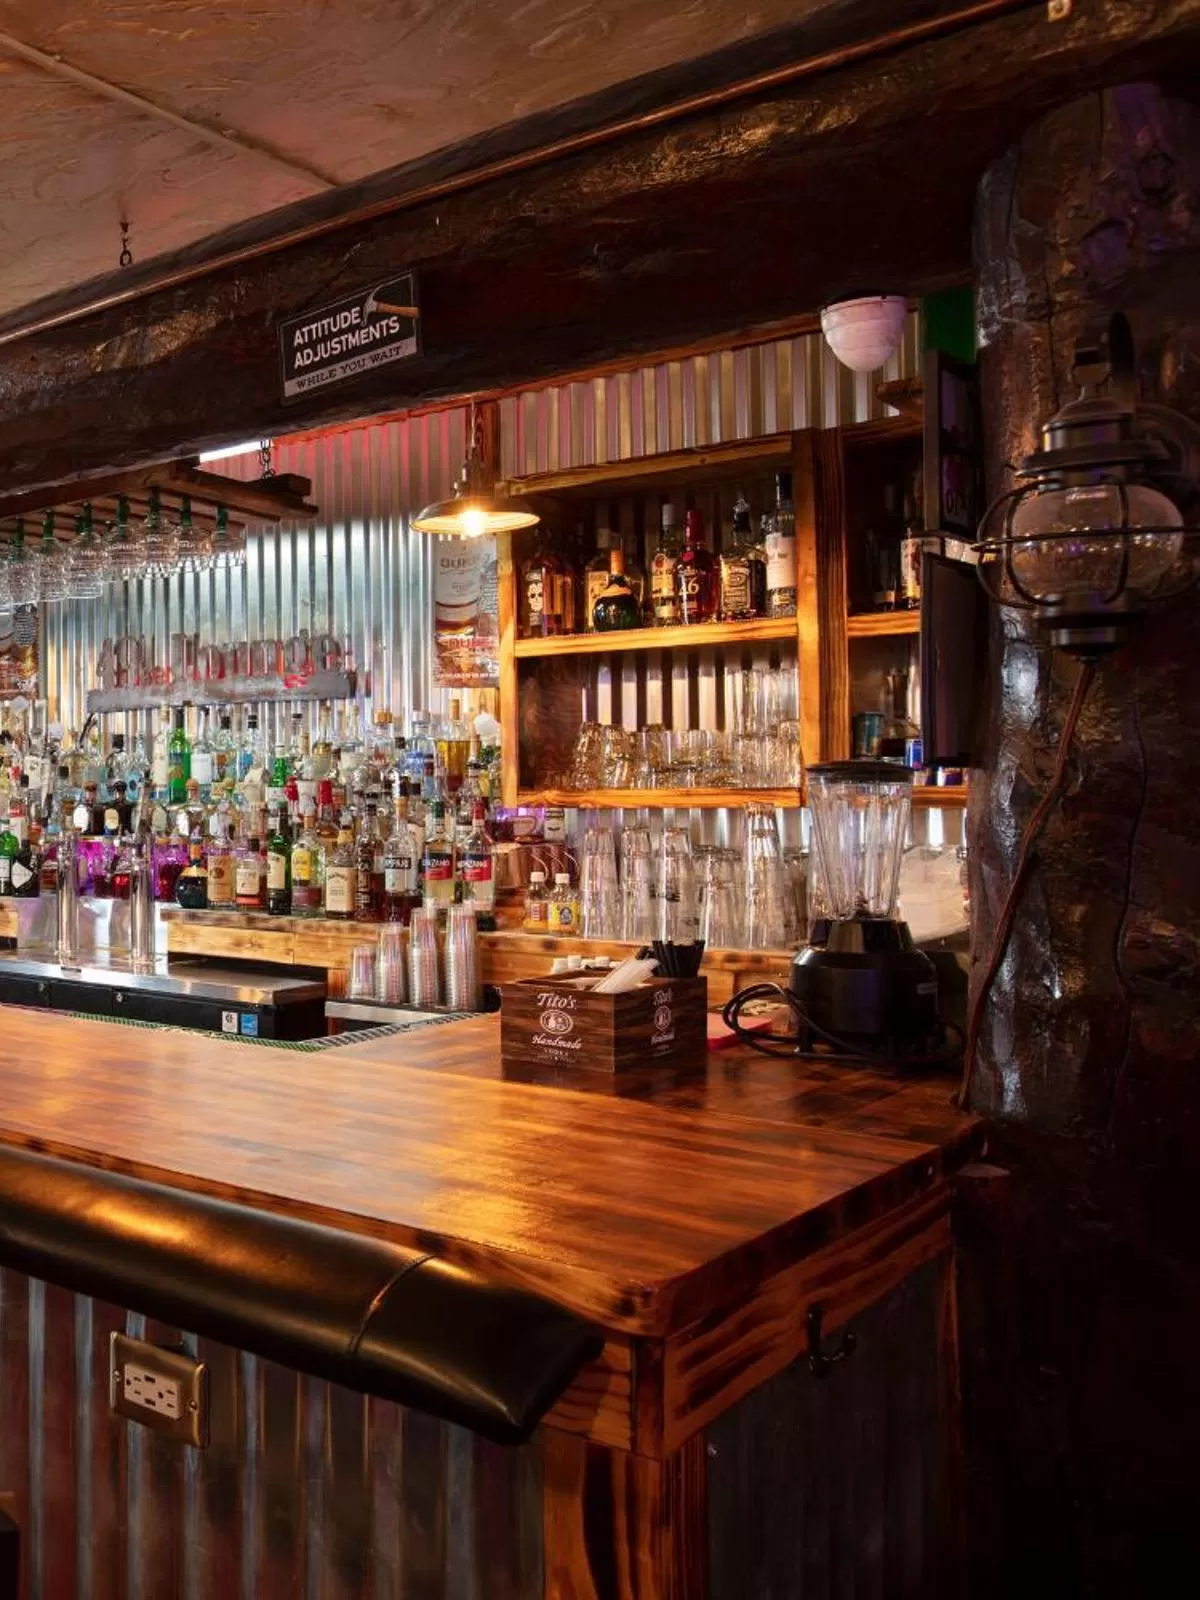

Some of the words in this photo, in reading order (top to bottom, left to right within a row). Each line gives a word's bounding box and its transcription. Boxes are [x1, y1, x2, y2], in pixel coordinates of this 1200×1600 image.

[294, 306, 362, 347] ATTITUDE
[294, 316, 400, 370] ADJUSTMENTS
[296, 369, 337, 390] WHILE
[341, 358, 367, 375] YOU
[370, 346, 402, 364] WAIT
[537, 992, 577, 1010] Tito's
[532, 1033, 582, 1049] Handmade
